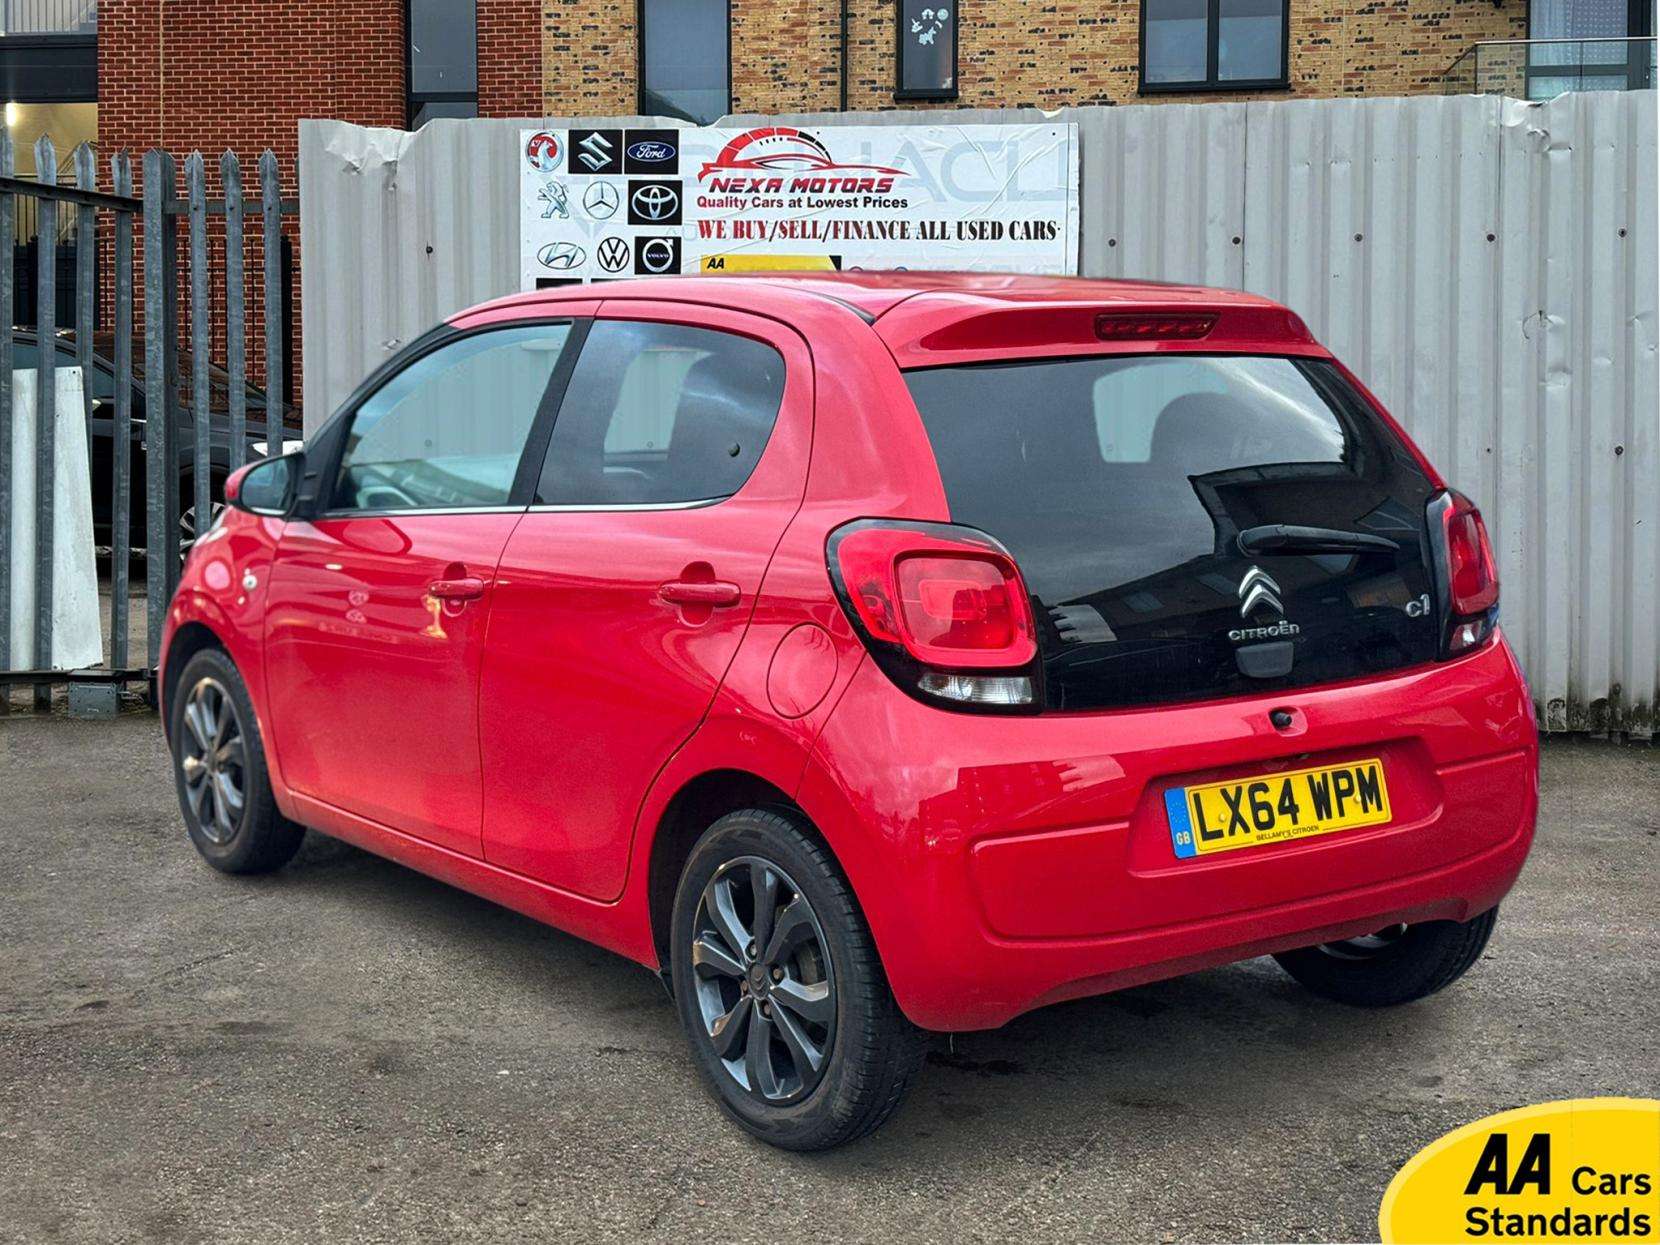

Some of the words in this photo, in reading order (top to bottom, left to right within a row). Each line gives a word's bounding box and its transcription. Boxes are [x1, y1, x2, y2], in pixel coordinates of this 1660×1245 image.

[635, 144, 667, 159] Ford
[708, 177, 783, 194] NEXA
[789, 177, 895, 194] MOTORS
[696, 195, 747, 211] Quality
[751, 196, 784, 209] Cars
[786, 197, 803, 209] at
[807, 196, 860, 209] Lowest
[863, 196, 909, 210] Prices
[699, 219, 727, 240] WE
[915, 220, 952, 241] ALL
[956, 219, 1004, 241] USED
[1008, 220, 1057, 241] CARS
[706, 257, 725, 270] AA
[1193, 777, 1300, 842] LX64
[1307, 765, 1383, 822] WPM
[1176, 831, 1192, 846] GB
